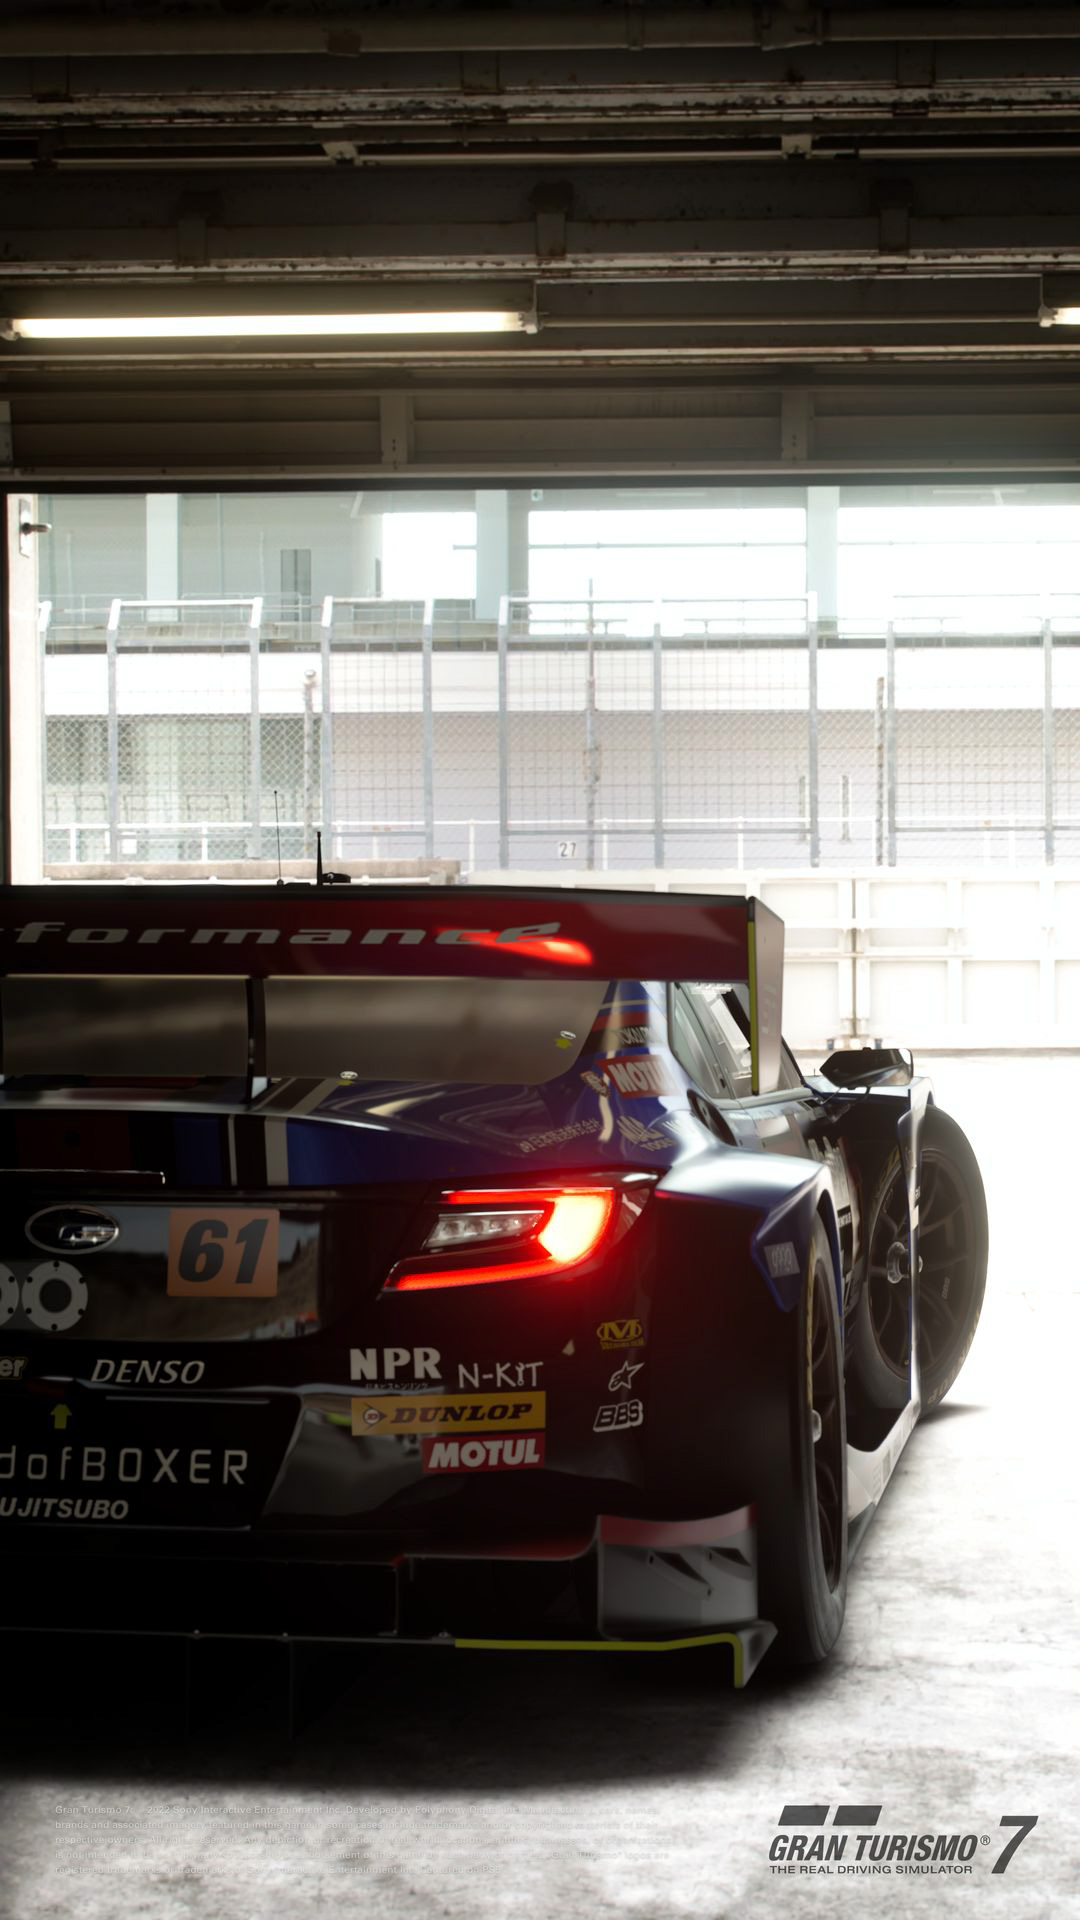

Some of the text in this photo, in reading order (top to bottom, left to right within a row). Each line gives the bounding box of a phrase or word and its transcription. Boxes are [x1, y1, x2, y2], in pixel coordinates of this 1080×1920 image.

[559, 842, 577, 858] 27
[0, 921, 561, 945] formance
[178, 1218, 269, 1285] 61
[90, 1358, 206, 1385] DENSO
[350, 1347, 442, 1381] NPR
[390, 1403, 533, 1425] DUNLOP
[593, 1399, 643, 1432] BBS
[428, 1438, 541, 1469] MOTUL
